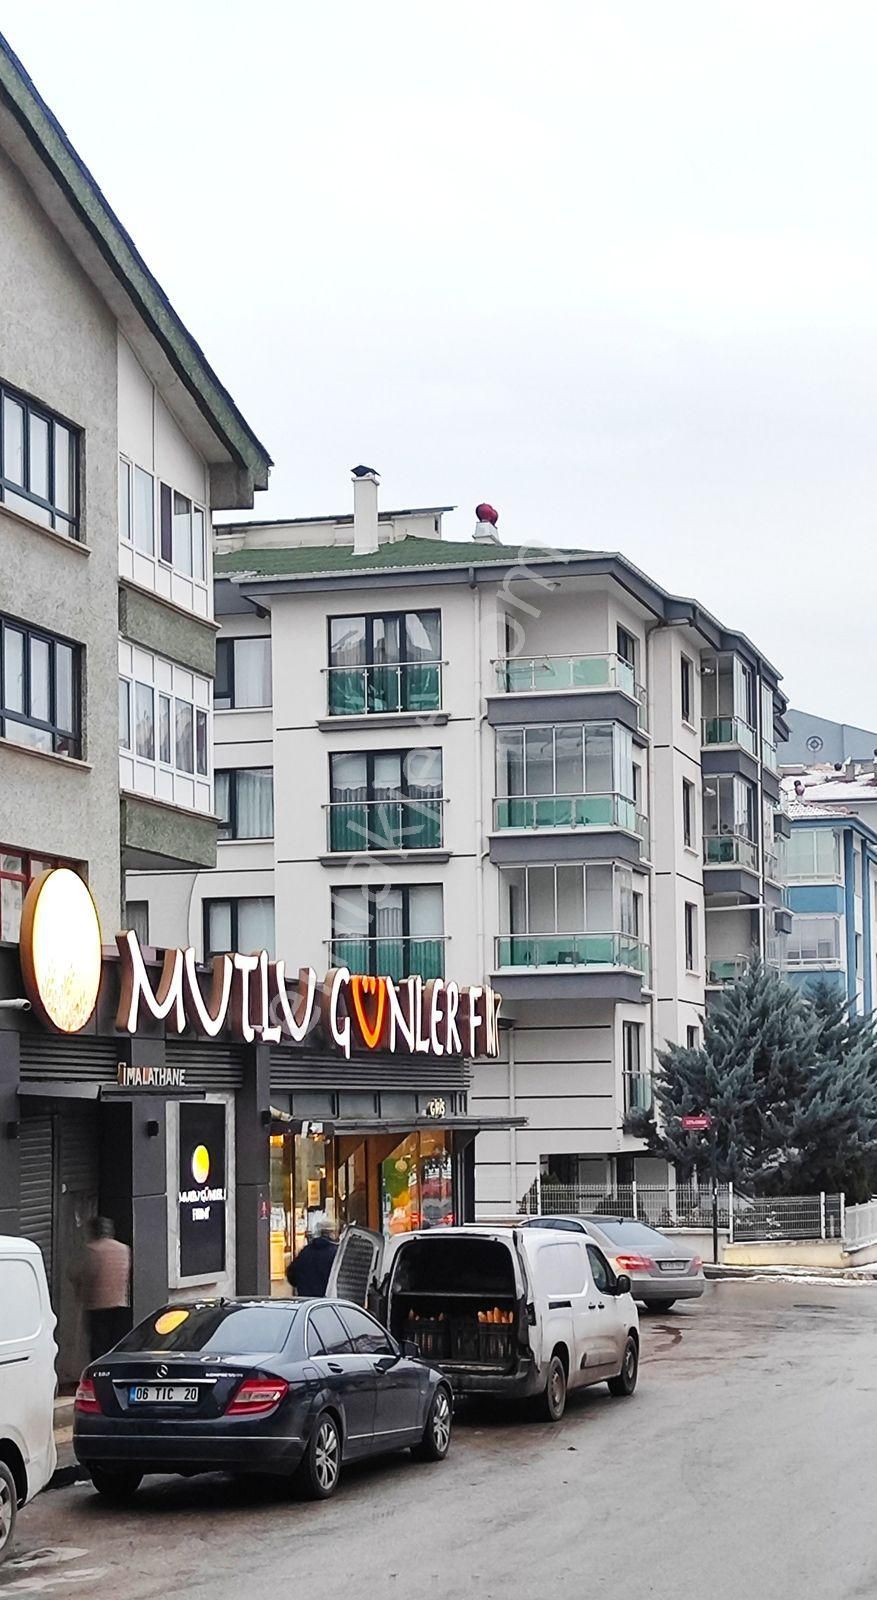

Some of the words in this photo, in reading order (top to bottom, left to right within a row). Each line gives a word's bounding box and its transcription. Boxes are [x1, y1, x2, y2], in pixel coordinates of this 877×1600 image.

[126, 929, 317, 1044] MUTLU
[330, 966, 463, 1060] GÜNLER
[136, 1387, 149, 1400] 06
[155, 1387, 174, 1400] TIC
[184, 1387, 197, 1400] 20
